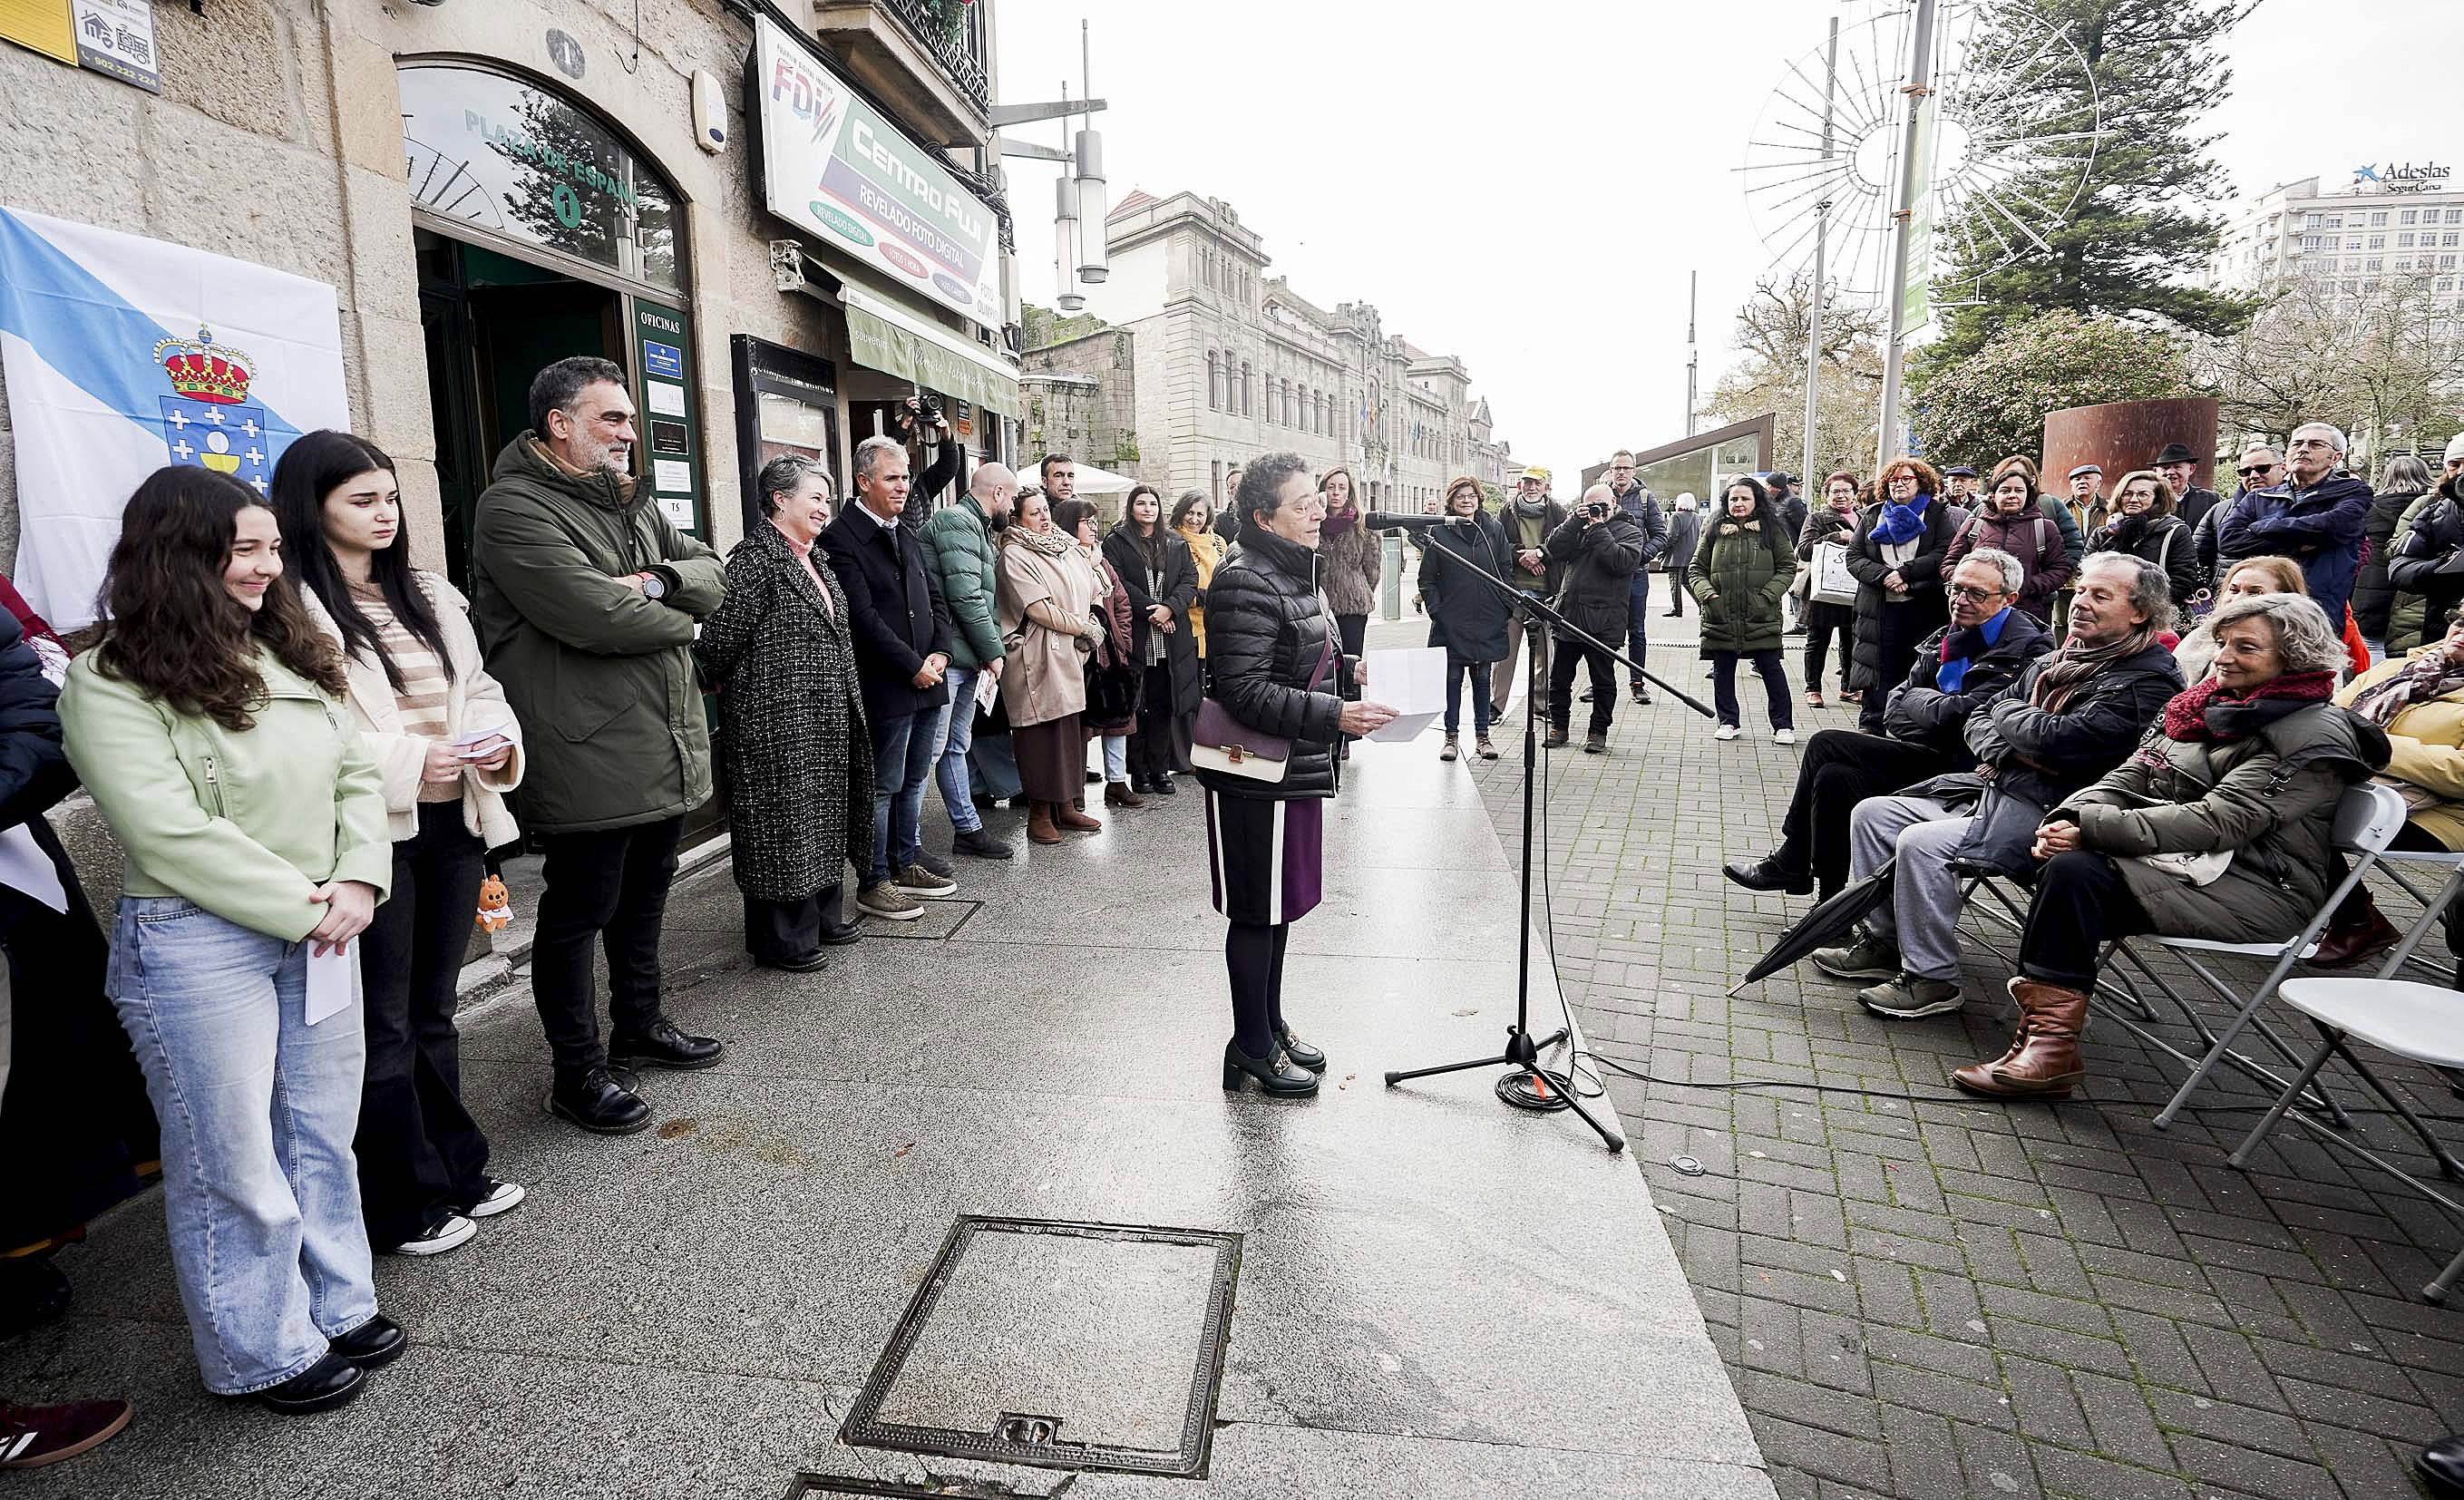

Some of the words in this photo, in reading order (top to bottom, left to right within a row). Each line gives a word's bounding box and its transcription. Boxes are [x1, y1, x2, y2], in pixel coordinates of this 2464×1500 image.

[465, 109, 538, 161] PLAZA
[543, 146, 569, 174] DE
[2380, 161, 2450, 180] Adeslas
[560, 191, 571, 219] 1
[817, 205, 847, 232] REVELADO
[848, 224, 867, 242] DIGITAL
[860, 185, 911, 233] REVELADO
[911, 221, 934, 248] FOTO
[936, 238, 964, 269] DIGITAL
[641, 312, 680, 334] OFICINAS
